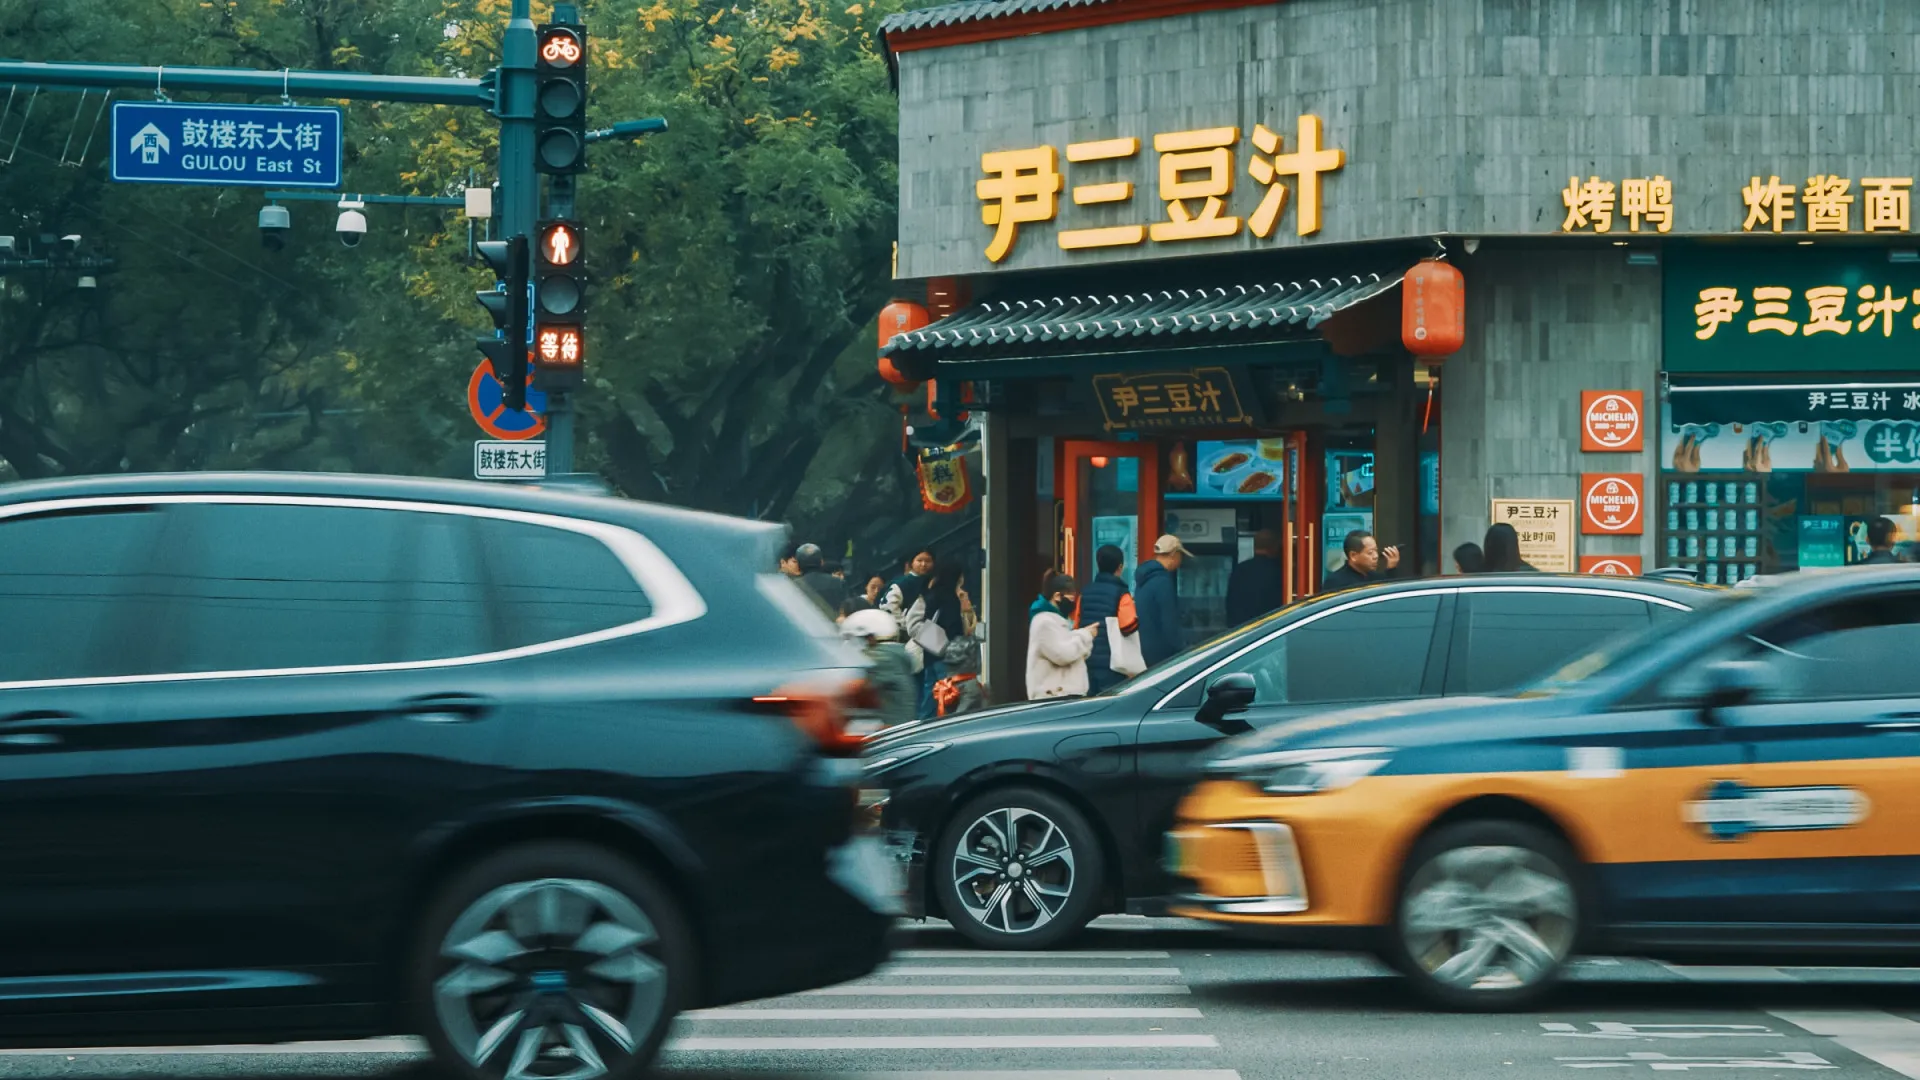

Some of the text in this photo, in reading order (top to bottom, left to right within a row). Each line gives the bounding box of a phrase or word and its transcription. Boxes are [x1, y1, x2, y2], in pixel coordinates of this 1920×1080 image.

[143, 133, 157, 148] 西
[182, 118, 322, 151] 鼓楼东大街
[145, 151, 155, 162] W
[182, 154, 322, 174] GULOU East St
[976, 114, 1345, 263] 尹三豆汁
[1562, 175, 1673, 233] 烤鸭
[1742, 175, 1914, 233] 炸酱面
[1694, 284, 1920, 341] 尹三豆汁
[540, 332, 578, 361] 等待
[1112, 381, 1222, 417] 尹三豆汁
[1808, 391, 1891, 411] 尹三豆汁
[1590, 412, 1635, 422] MICHELIN
[480, 449, 545, 470] 鼓楼东大街
[1590, 495, 1635, 505] MICHELIN
[1507, 506, 1559, 519] 尹三豆汁
[1516, 532, 1556, 543] 业时间
